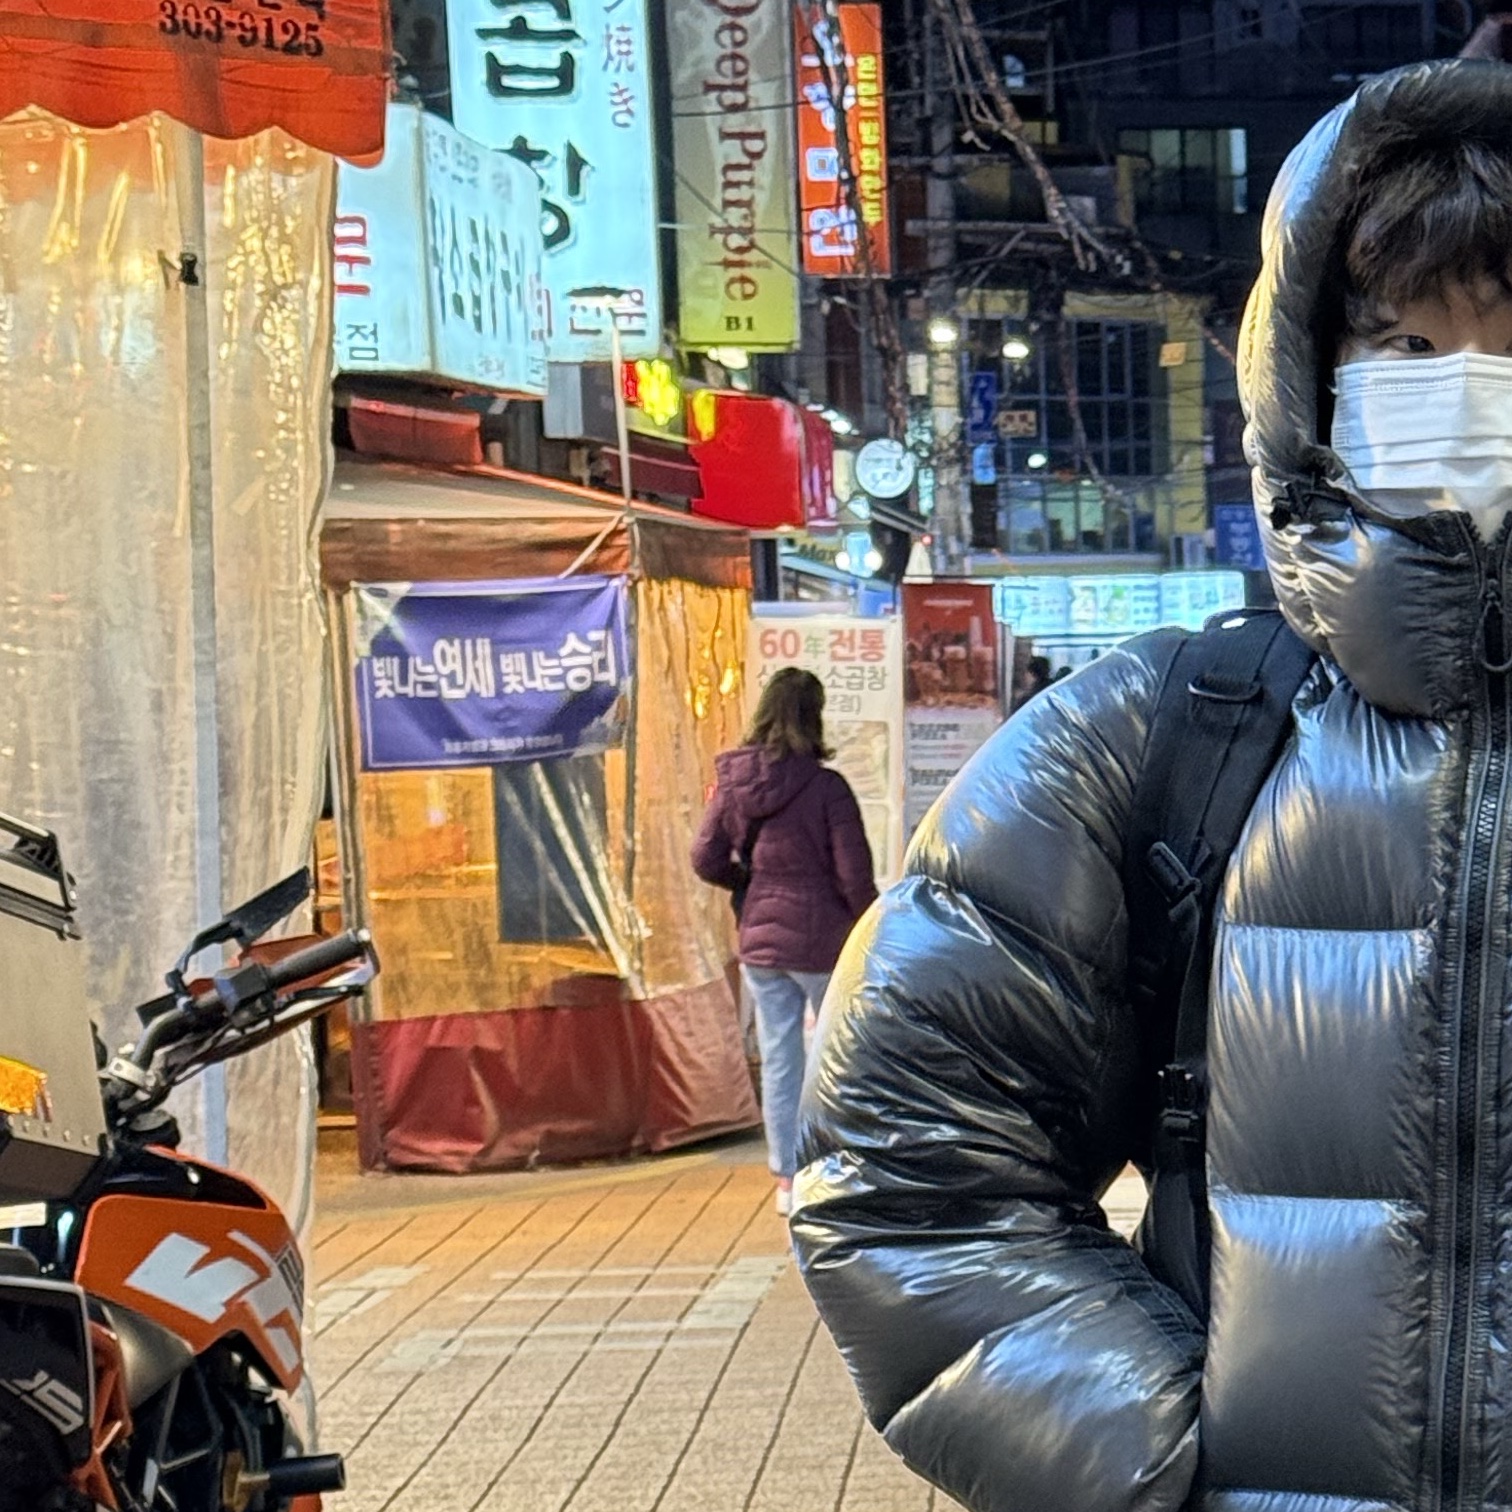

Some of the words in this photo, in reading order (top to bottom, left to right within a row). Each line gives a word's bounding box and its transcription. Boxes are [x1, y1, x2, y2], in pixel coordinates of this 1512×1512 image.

[159, 0, 324, 57] 303-9125
[706, 127, 770, 302] Purple
[724, 315, 756, 331] B1
[829, 628, 887, 662] 전통
